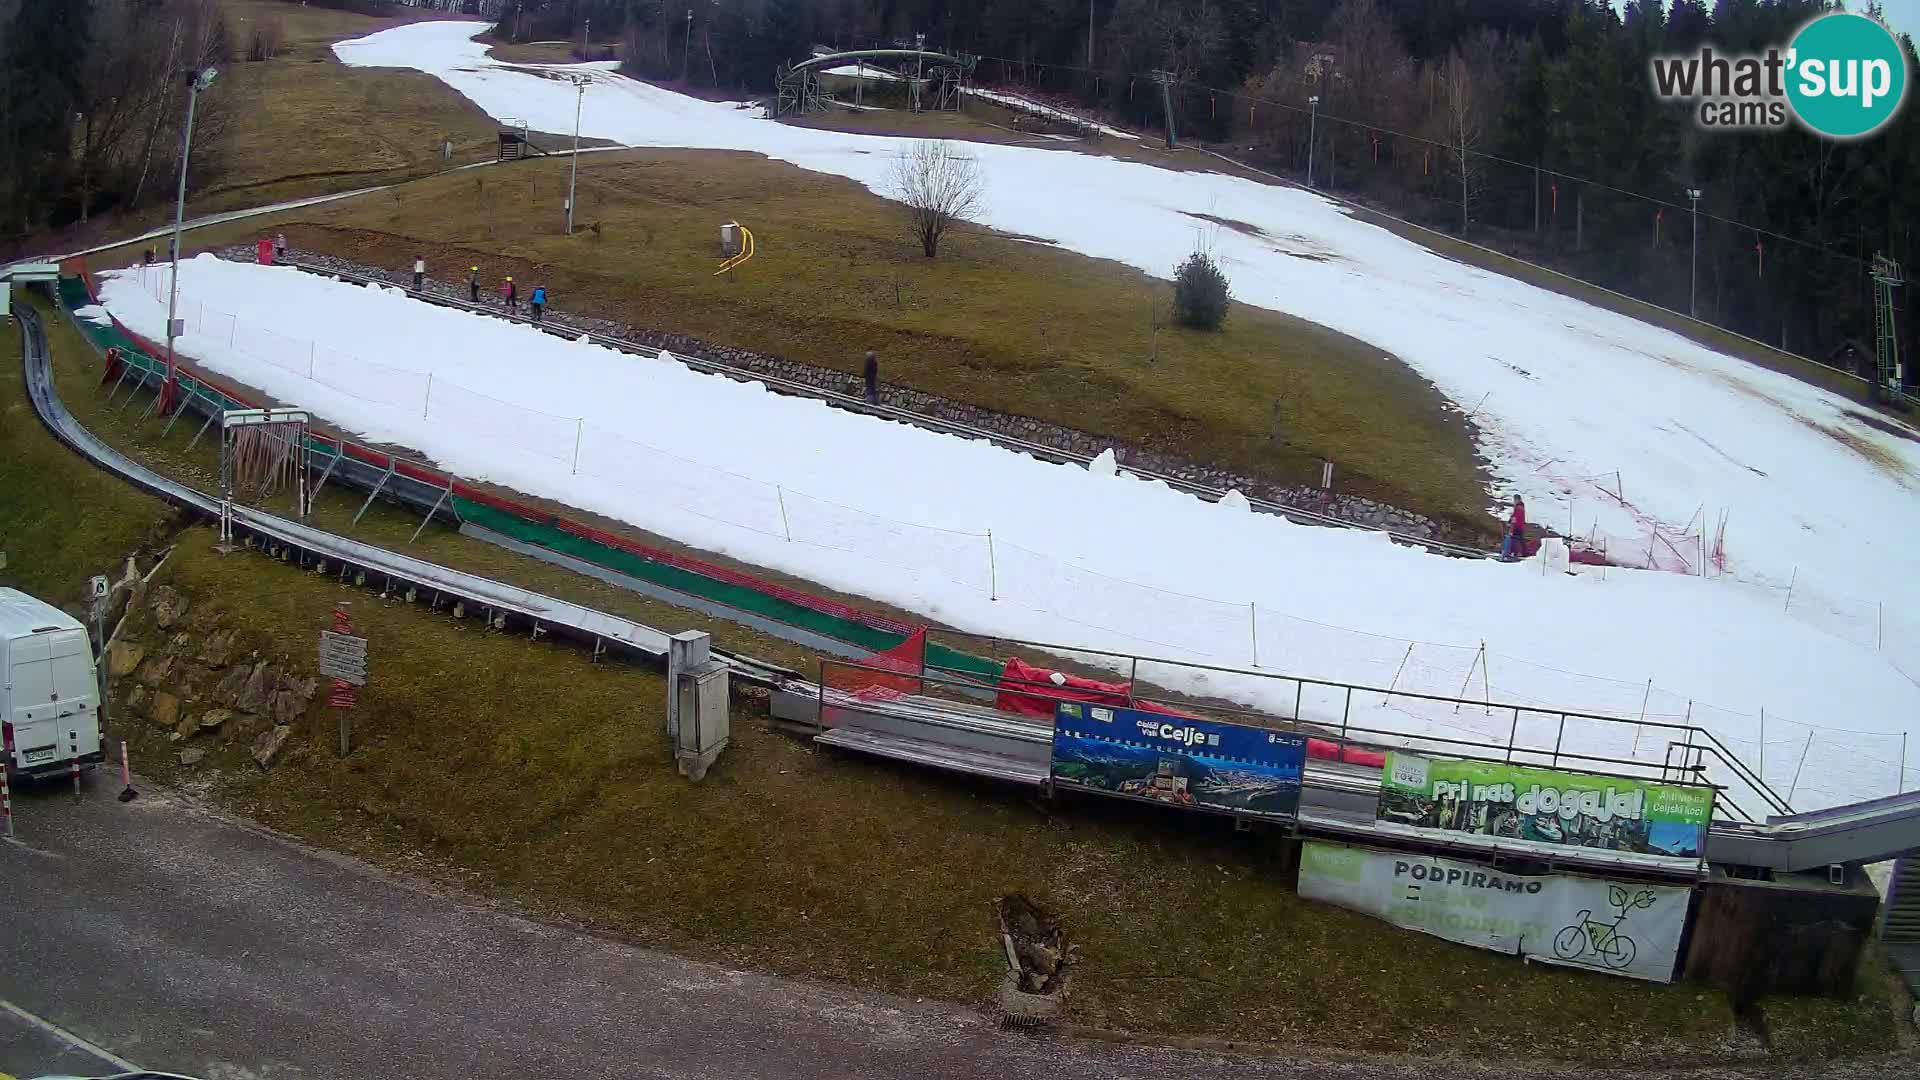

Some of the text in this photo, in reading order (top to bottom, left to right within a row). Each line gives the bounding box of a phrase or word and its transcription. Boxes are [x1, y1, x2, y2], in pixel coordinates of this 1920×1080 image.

[1160, 724, 1205, 746] Celje
[1432, 780, 1468, 801] Pri
[1472, 783, 1515, 803] nas
[1395, 861, 1542, 894] PODPIRAMO
